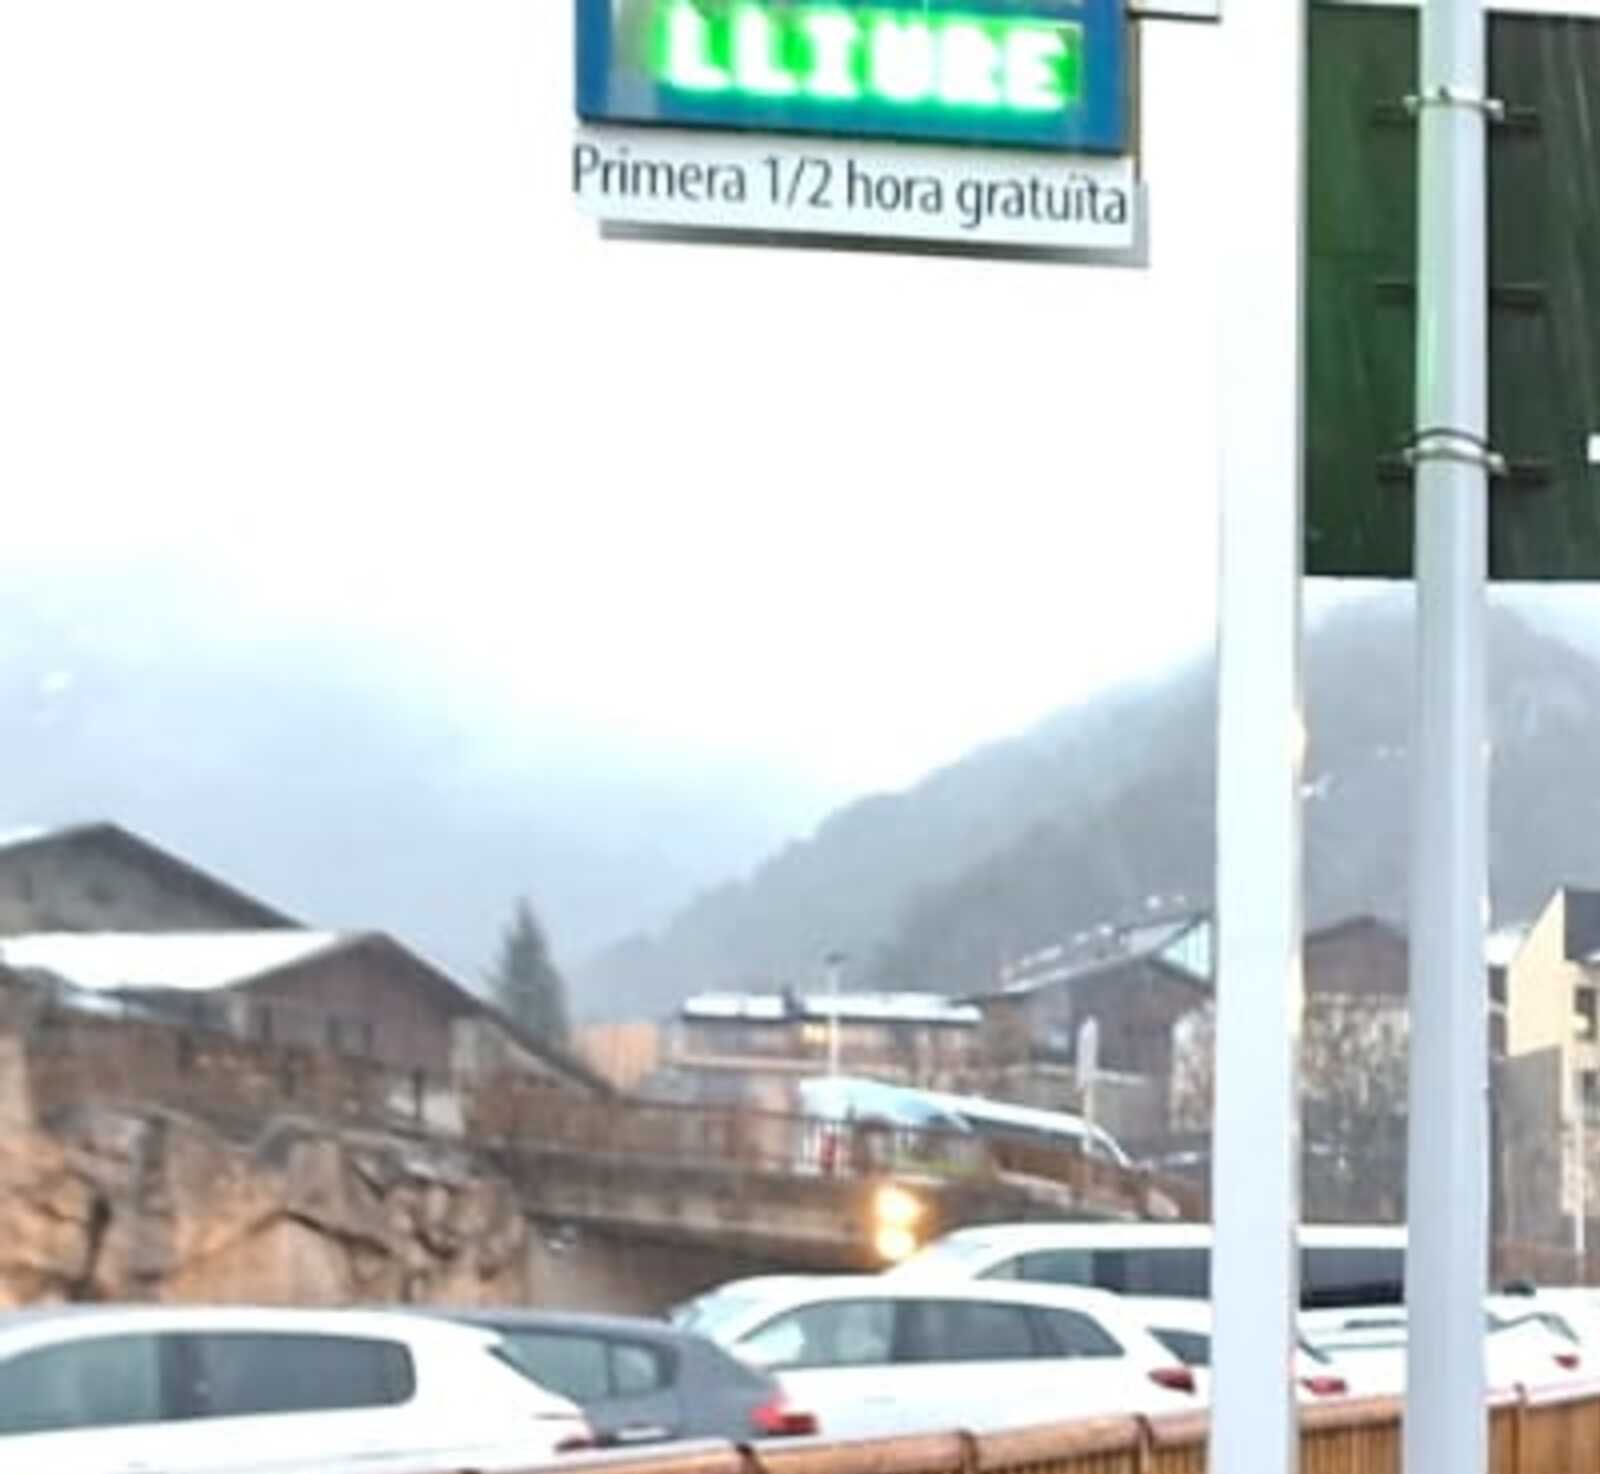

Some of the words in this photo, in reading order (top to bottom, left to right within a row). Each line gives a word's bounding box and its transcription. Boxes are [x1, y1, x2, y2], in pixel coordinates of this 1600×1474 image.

[660, 4, 1070, 112] LLIURE
[572, 144, 747, 202] Primera
[764, 157, 833, 210] 1/2
[847, 159, 943, 215] hora
[957, 172, 1128, 228] gratuïta
